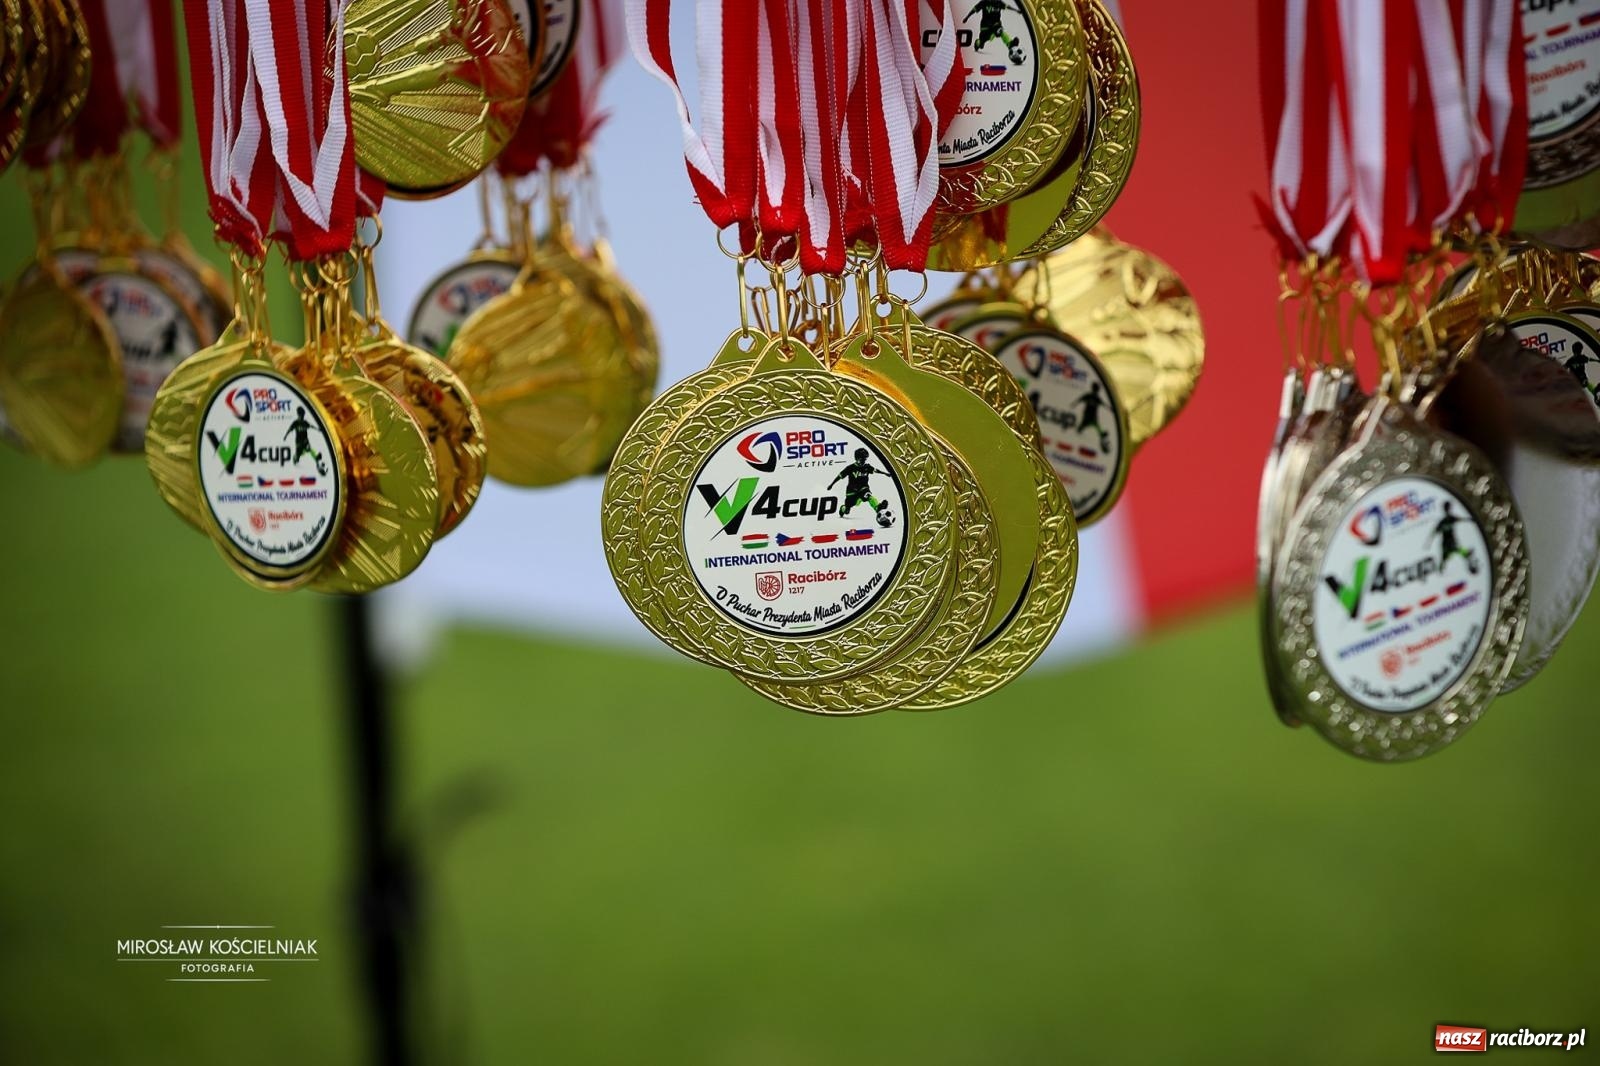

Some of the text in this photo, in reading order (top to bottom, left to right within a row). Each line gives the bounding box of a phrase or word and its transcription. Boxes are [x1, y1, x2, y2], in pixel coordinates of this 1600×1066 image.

[966, 82, 1022, 92] RNAMENT
[952, 135, 978, 154] Miasta
[978, 110, 1016, 144] Raciborza
[1520, 332, 1548, 348] PRO
[1540, 339, 1566, 355] ORT
[254, 388, 277, 401] PRO
[786, 430, 826, 446] PRO
[786, 442, 848, 460] SPORT
[797, 460, 834, 468] ACTIVE
[704, 544, 890, 568] INTERNATIONAL TOURNAMENT
[788, 570, 847, 584] Racibórz
[788, 586, 805, 594] 1217
[726, 594, 762, 618] Puchar
[763, 607, 812, 627] Prezydenta
[814, 603, 842, 622] Miasta
[842, 572, 882, 610] Raciborza
